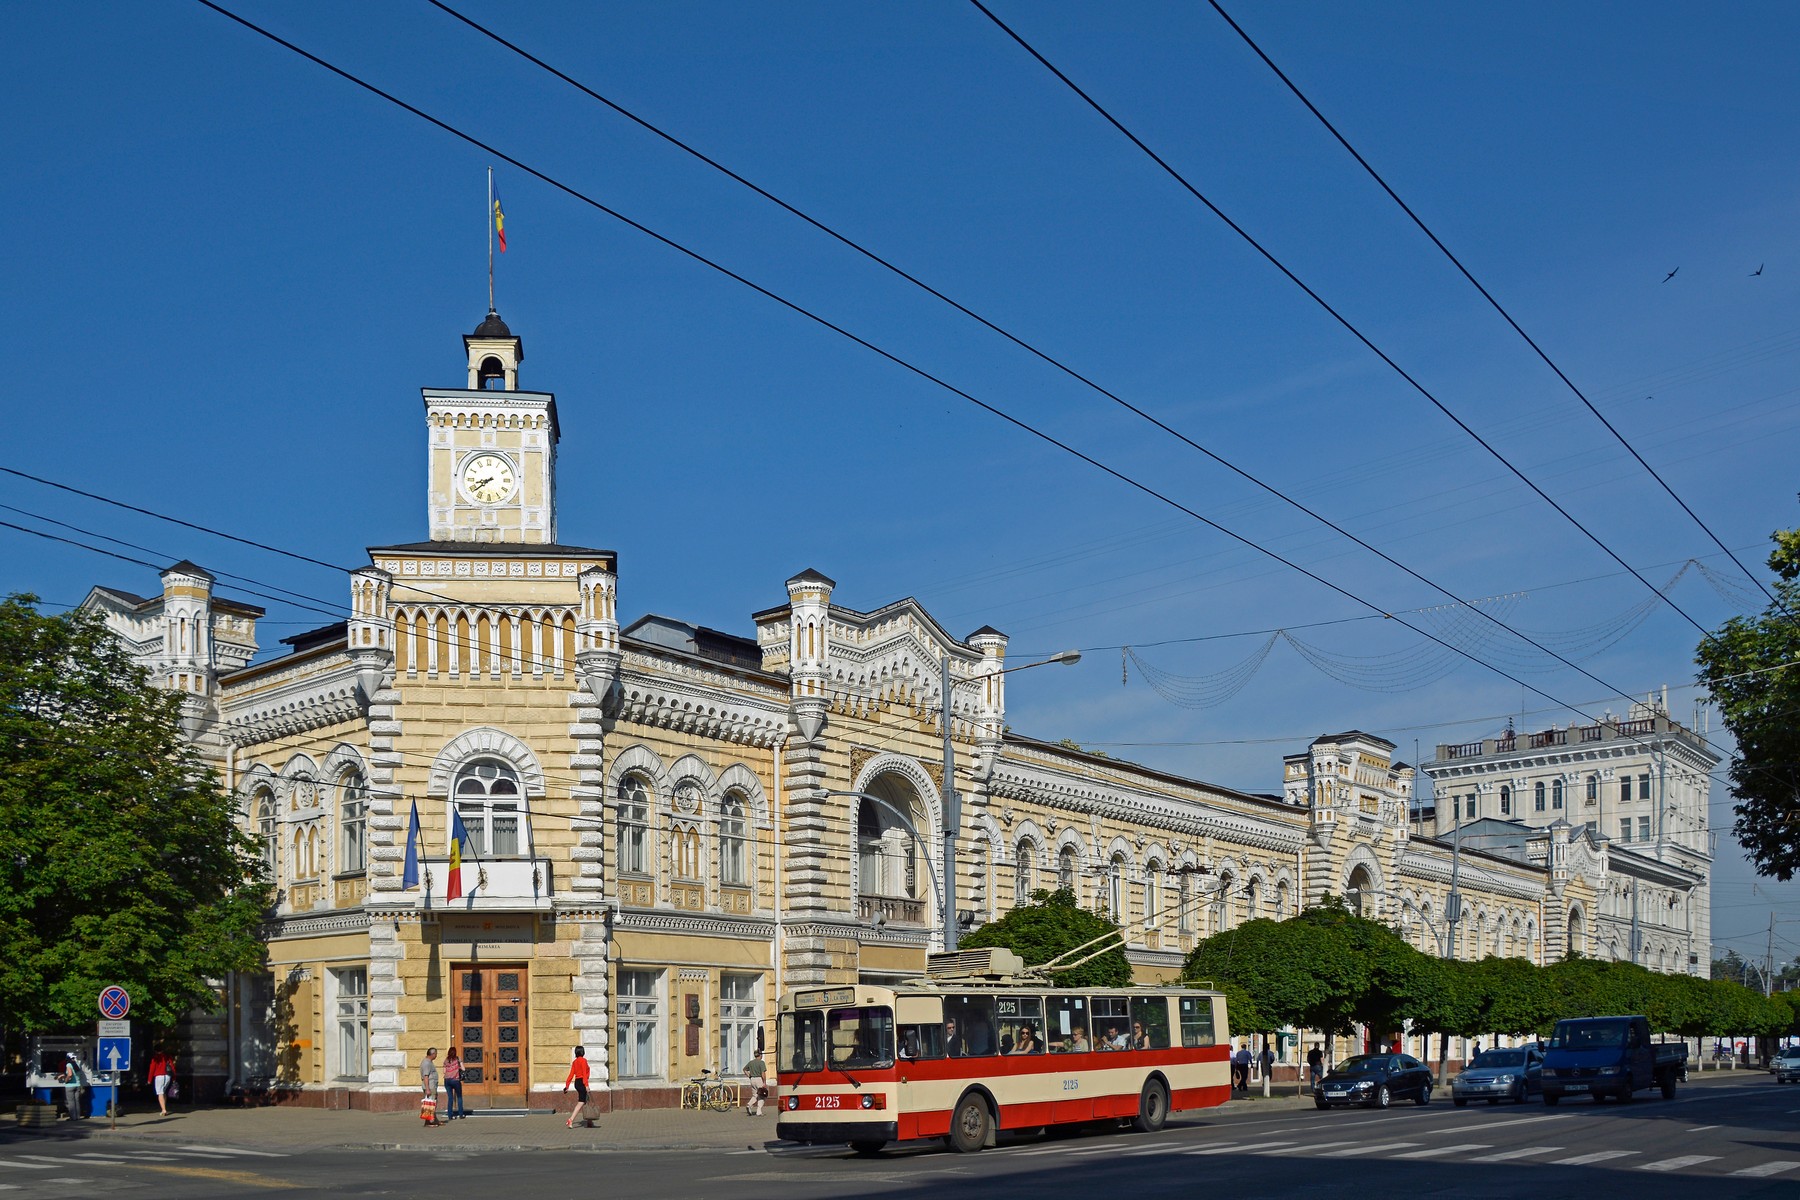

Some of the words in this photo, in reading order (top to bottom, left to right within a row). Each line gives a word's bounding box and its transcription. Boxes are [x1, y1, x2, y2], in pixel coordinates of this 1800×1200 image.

[823, 991, 829, 1003] 5
[998, 1001, 1016, 1013] 2125
[1063, 1079, 1079, 1090] 2125
[815, 1096, 840, 1108] 2125
